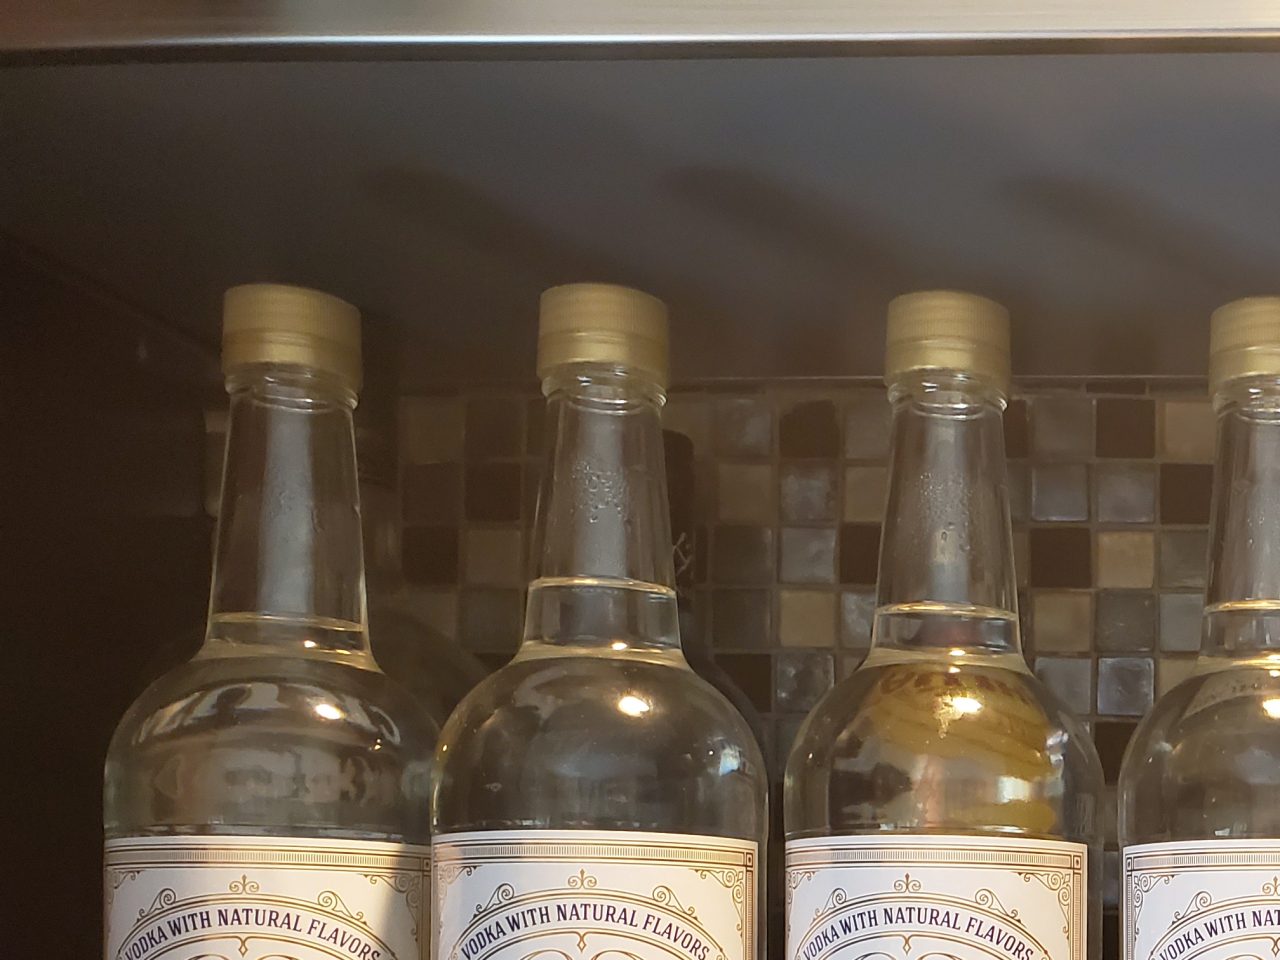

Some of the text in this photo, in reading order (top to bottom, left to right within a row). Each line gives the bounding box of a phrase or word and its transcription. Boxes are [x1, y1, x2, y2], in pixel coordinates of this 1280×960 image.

[168, 912, 211, 936] WITH
[217, 908, 302, 933] NATURAL
[461, 924, 506, 960] VODKA
[506, 910, 550, 933] WITH
[556, 904, 638, 927] NATURAL
[839, 909, 878, 935] WITH
[883, 907, 961, 930] NATURAL
[1204, 912, 1246, 937] WITH
